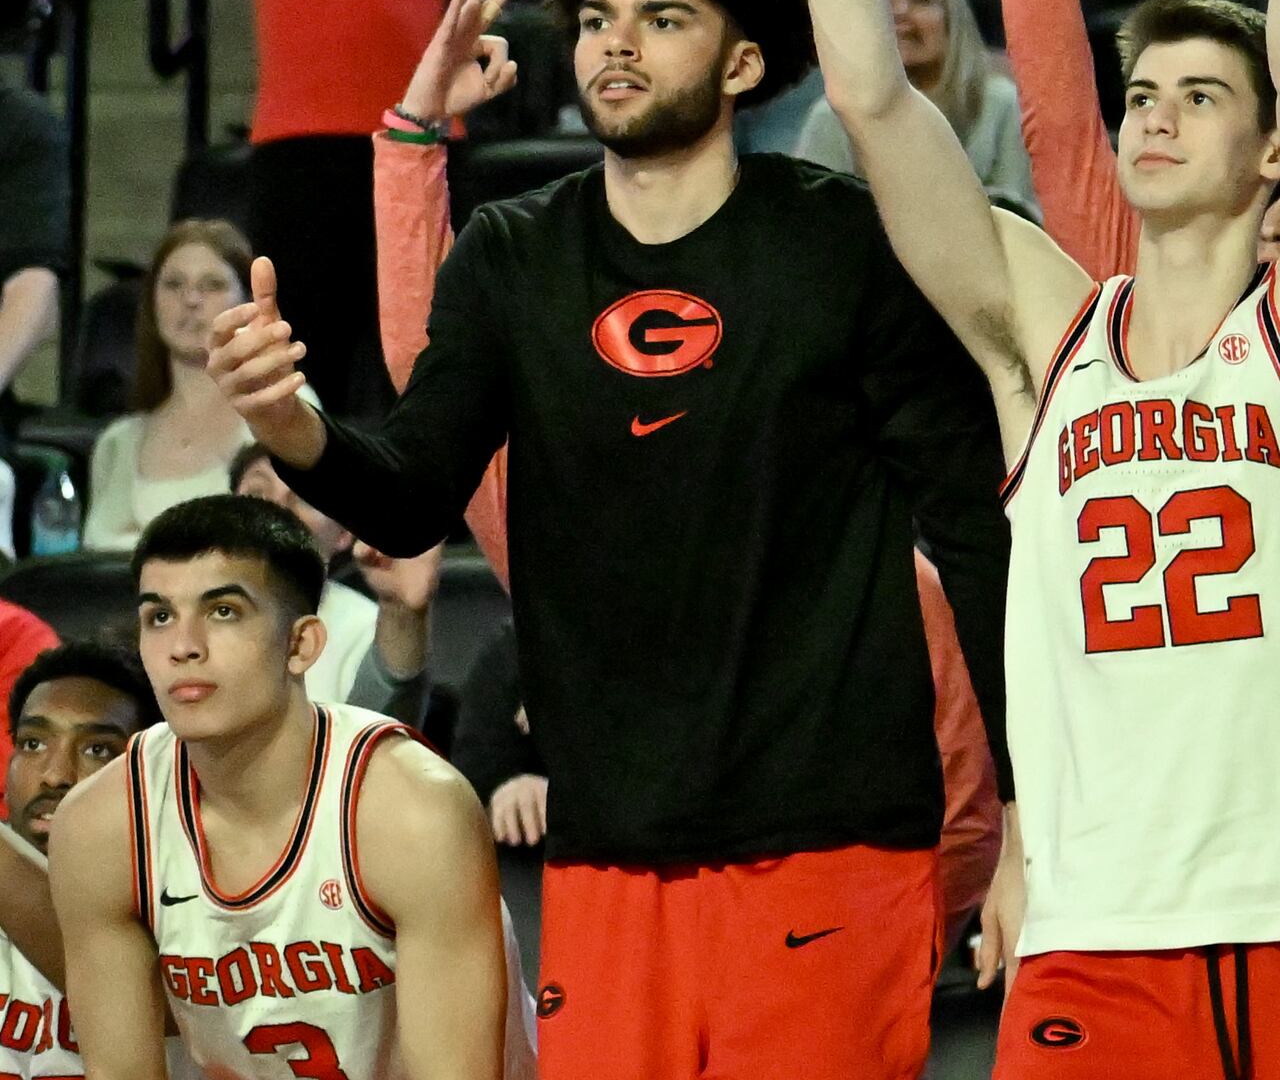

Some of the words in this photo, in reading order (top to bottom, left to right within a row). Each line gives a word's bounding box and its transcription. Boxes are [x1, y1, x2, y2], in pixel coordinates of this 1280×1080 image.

[591, 288, 723, 378] G
[1220, 337, 1249, 362] SEC
[1058, 398, 1280, 497] GEORGIA
[1077, 484, 1265, 655] 22
[159, 940, 397, 1007] GEORGIA
[1029, 1016, 1086, 1049] G
